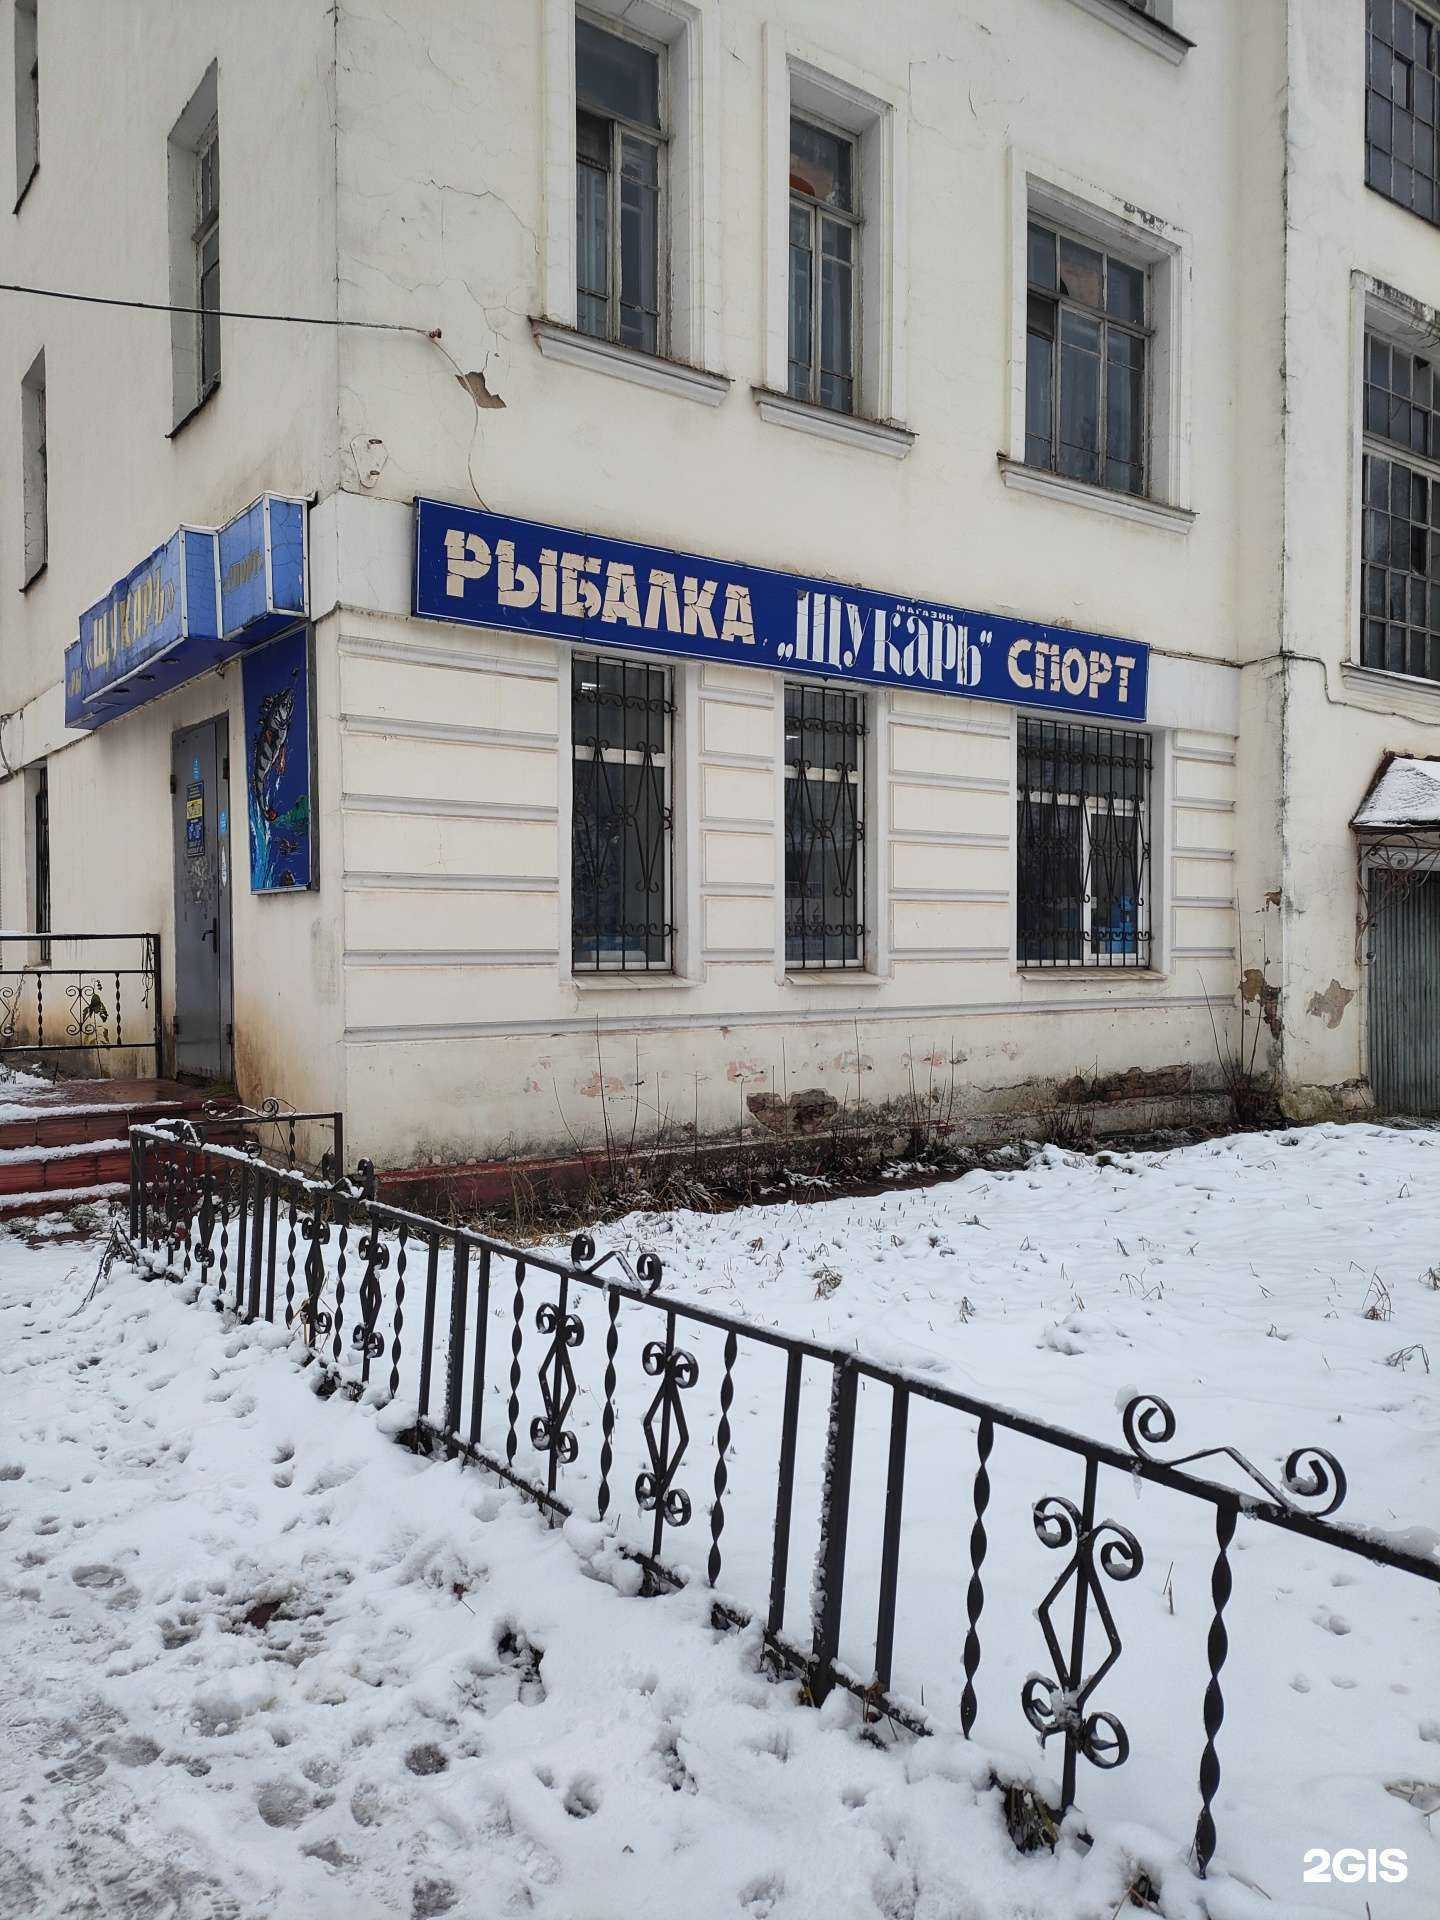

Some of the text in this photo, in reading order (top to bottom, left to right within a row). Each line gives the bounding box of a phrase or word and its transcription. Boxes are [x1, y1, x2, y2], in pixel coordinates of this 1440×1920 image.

[443, 528, 756, 645] РЫБАЛКА
[1007, 637, 1136, 703] СПОРТ
[895, 603, 955, 622] МАГАЗИН
